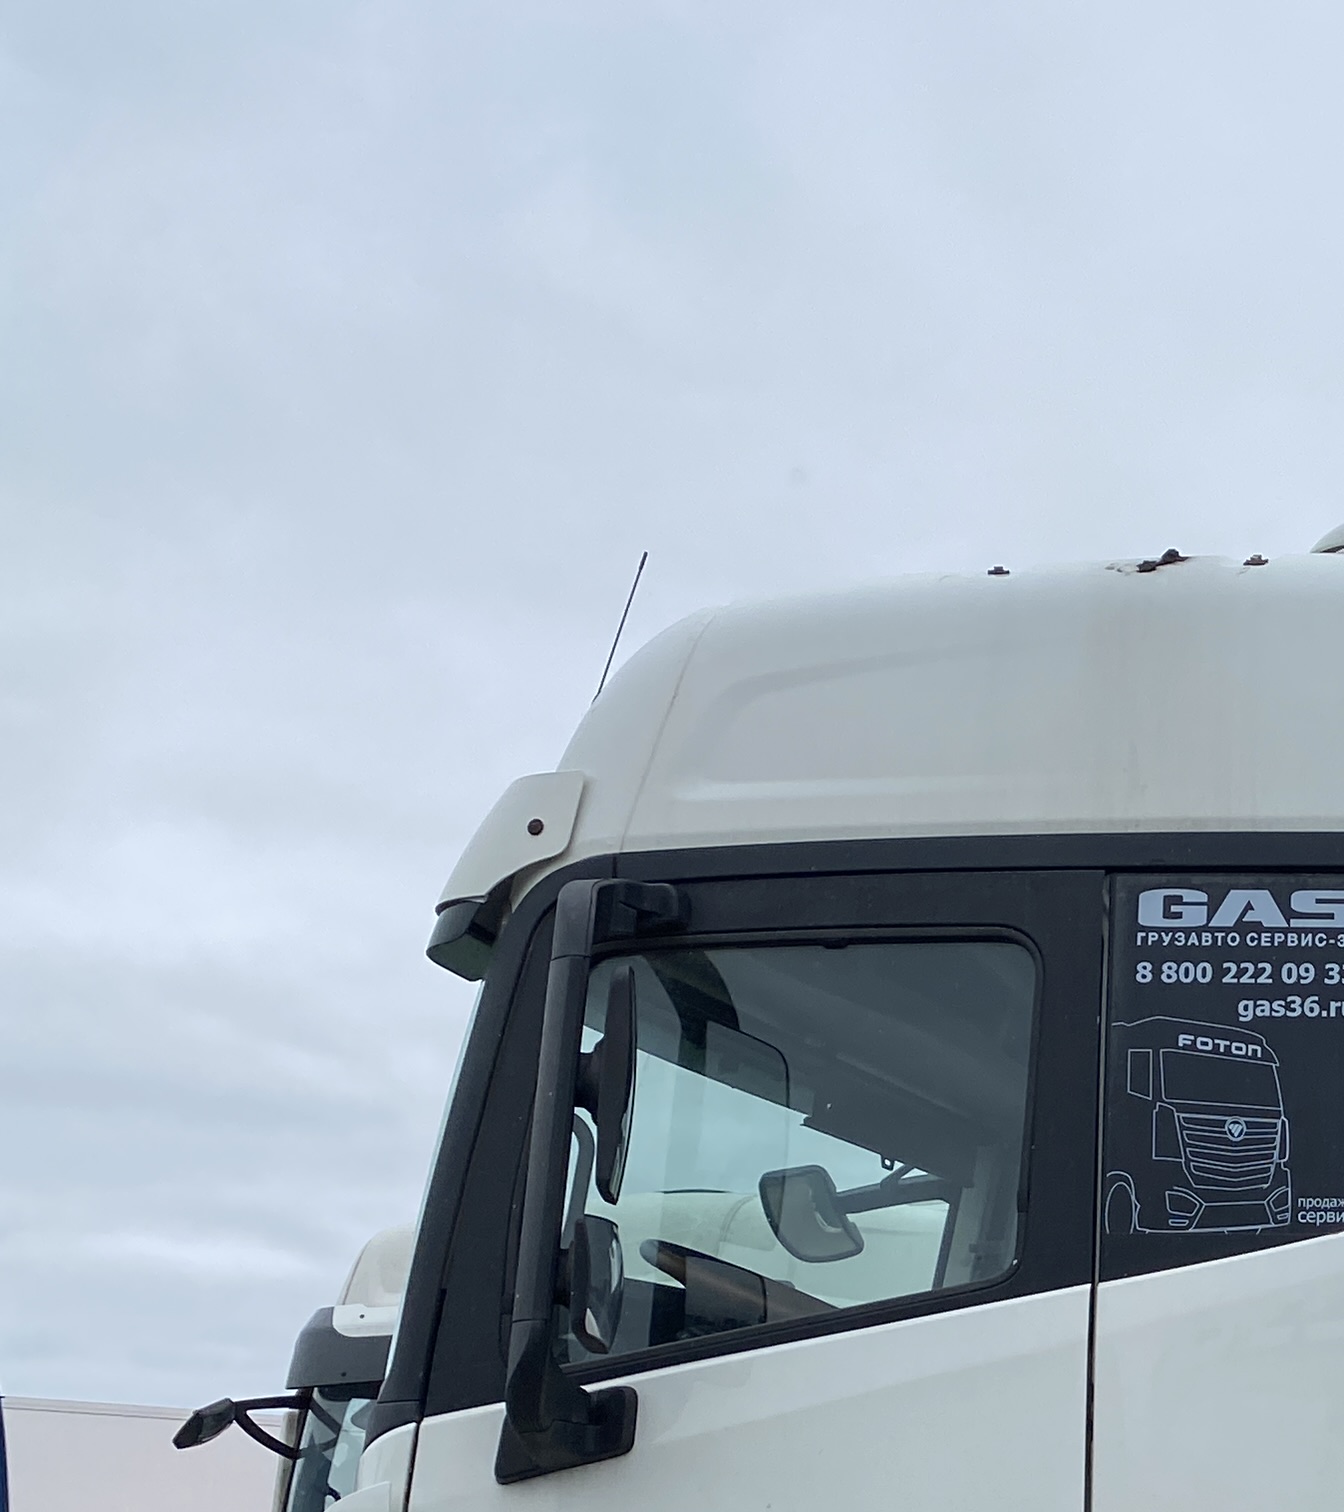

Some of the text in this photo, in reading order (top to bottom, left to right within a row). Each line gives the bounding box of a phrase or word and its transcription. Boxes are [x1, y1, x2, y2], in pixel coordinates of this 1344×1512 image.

[1136, 932, 1241, 946] ГРУЗАВТО
[1135, 961, 1153, 984] 8
[1160, 961, 1213, 984] 800
[1221, 962, 1273, 984] 222
[1281, 962, 1315, 984] 09
[1178, 1033, 1262, 1058] FOTON
